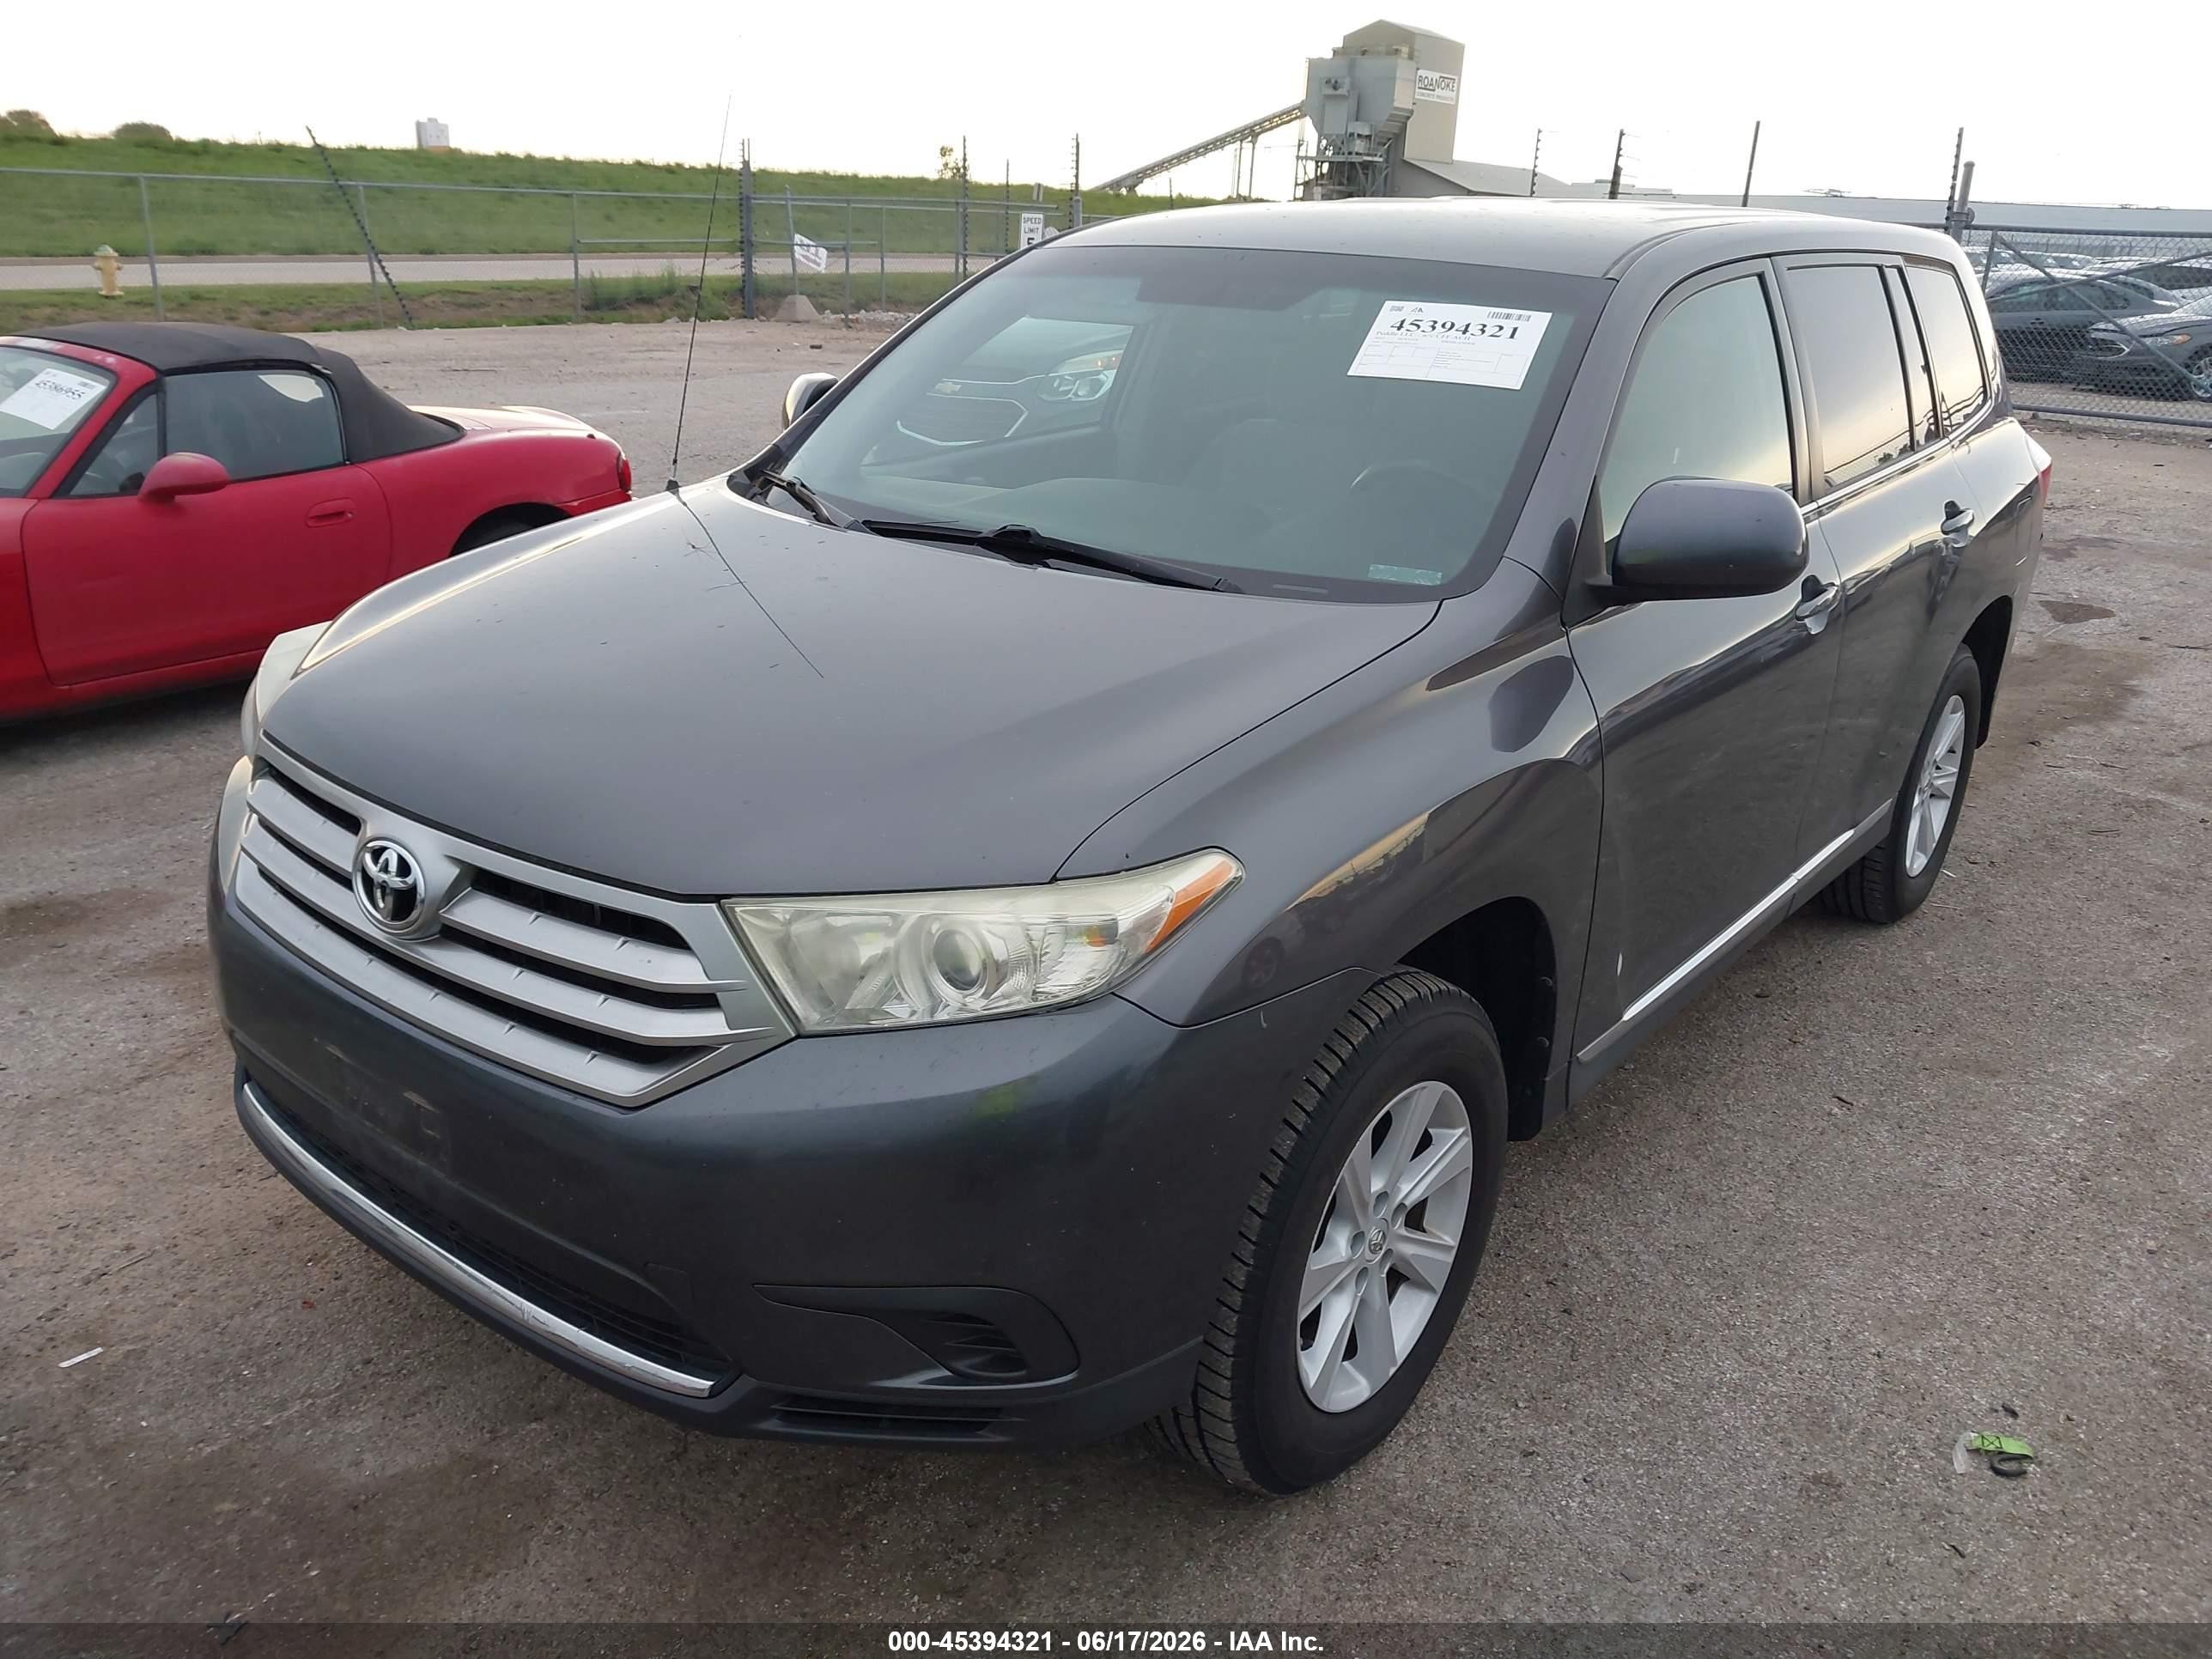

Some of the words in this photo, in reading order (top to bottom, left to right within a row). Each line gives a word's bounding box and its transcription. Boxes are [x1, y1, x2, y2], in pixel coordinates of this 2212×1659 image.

[1418, 75, 1456, 92] ROANOKE
[1023, 216, 1042, 225] SPEED
[1389, 318, 1520, 340] 45394321
